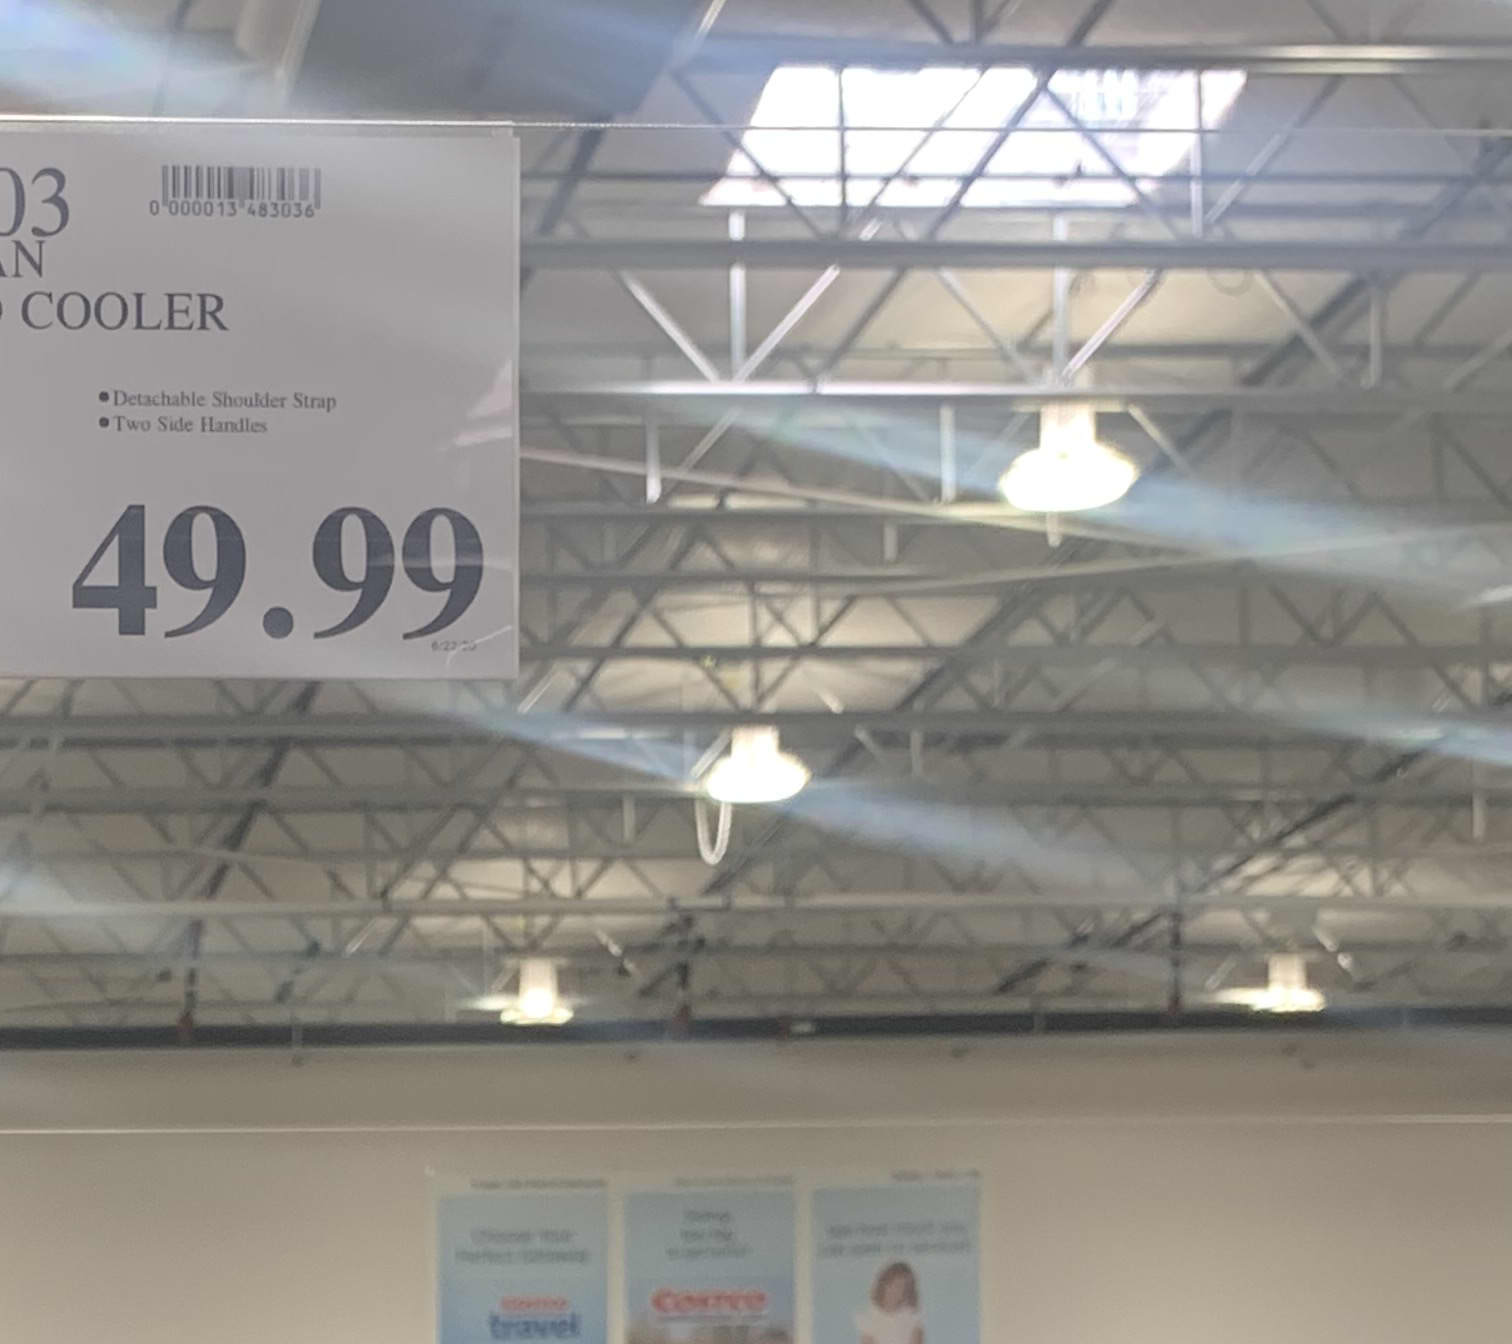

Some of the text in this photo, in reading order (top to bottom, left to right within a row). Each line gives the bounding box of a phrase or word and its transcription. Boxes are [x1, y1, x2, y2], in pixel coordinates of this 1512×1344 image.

[21, 291, 230, 332] COOLER
[113, 390, 337, 412] Detachable Shoulder Strap
[113, 416, 268, 434] Two Side Handles
[72, 504, 485, 640] 49.99
